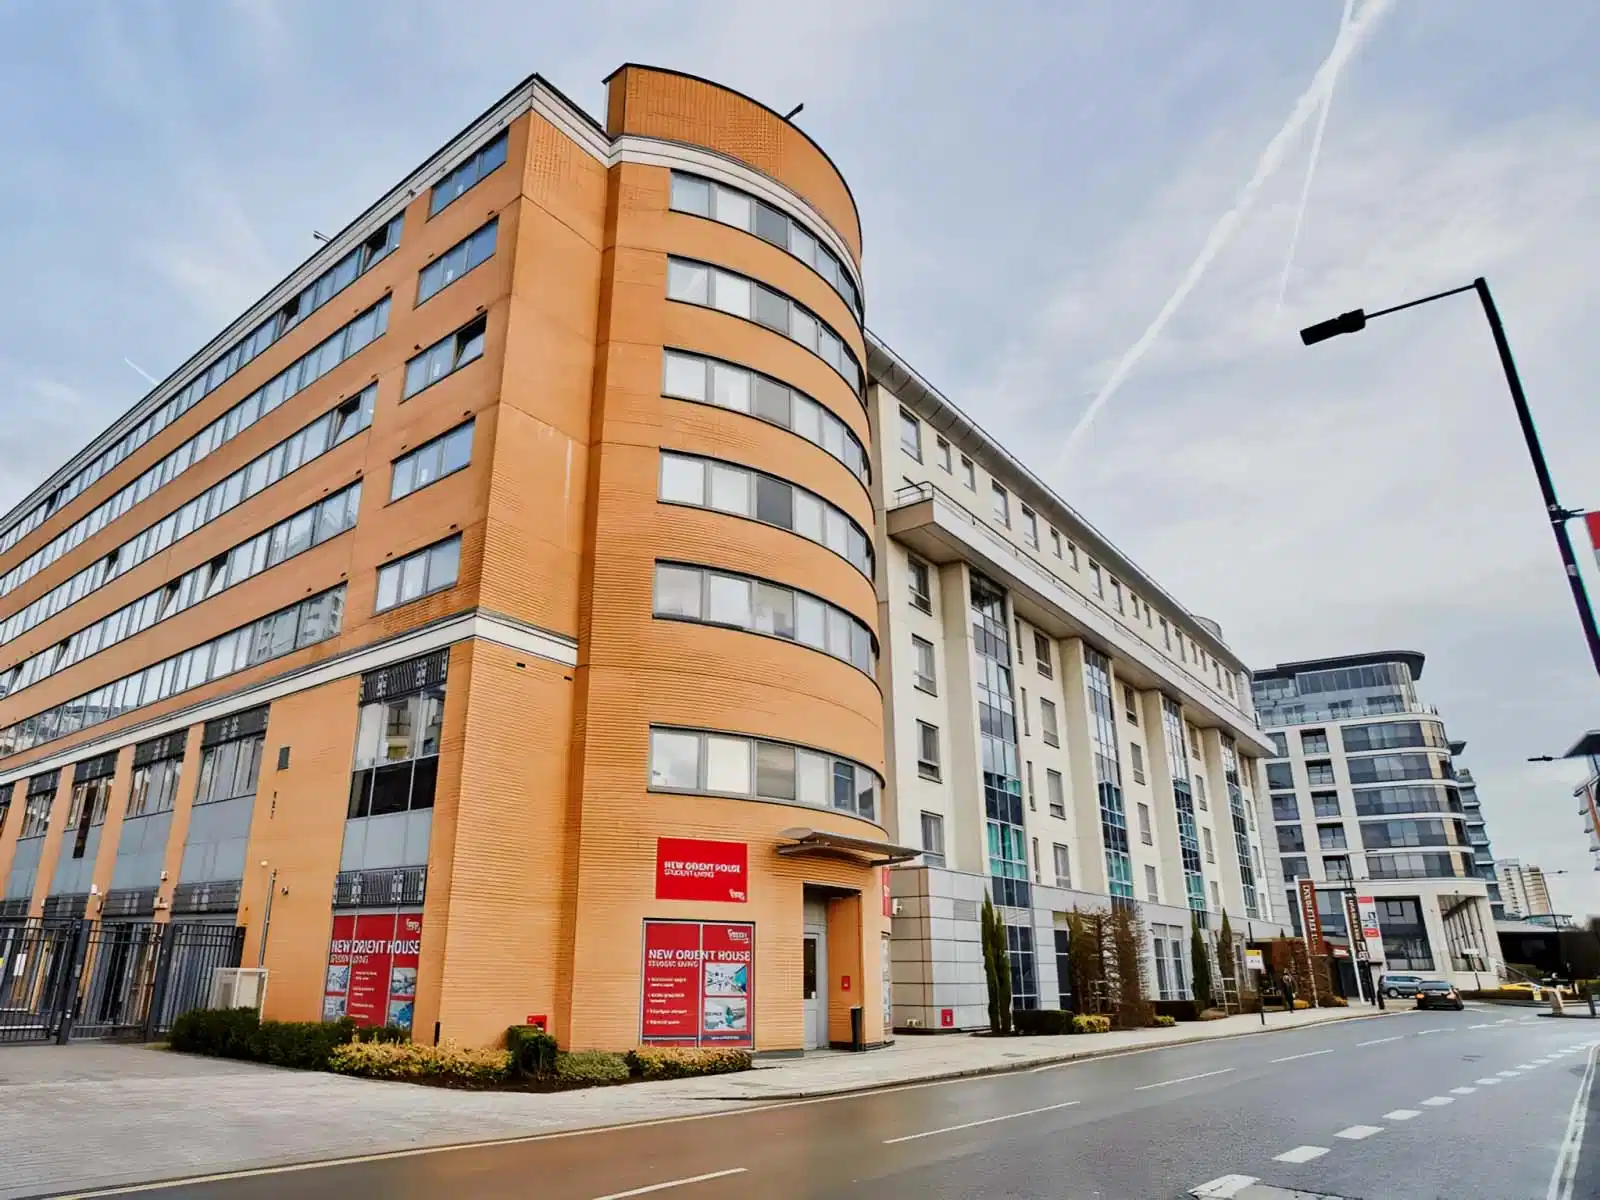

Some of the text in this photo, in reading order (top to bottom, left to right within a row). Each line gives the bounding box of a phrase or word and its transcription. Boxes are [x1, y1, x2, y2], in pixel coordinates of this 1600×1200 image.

[664, 861, 683, 870] NEW
[331, 939, 420, 954] NEW ORIENT HOUSE
[648, 949, 751, 961] NEW ORIENT HOUSE
